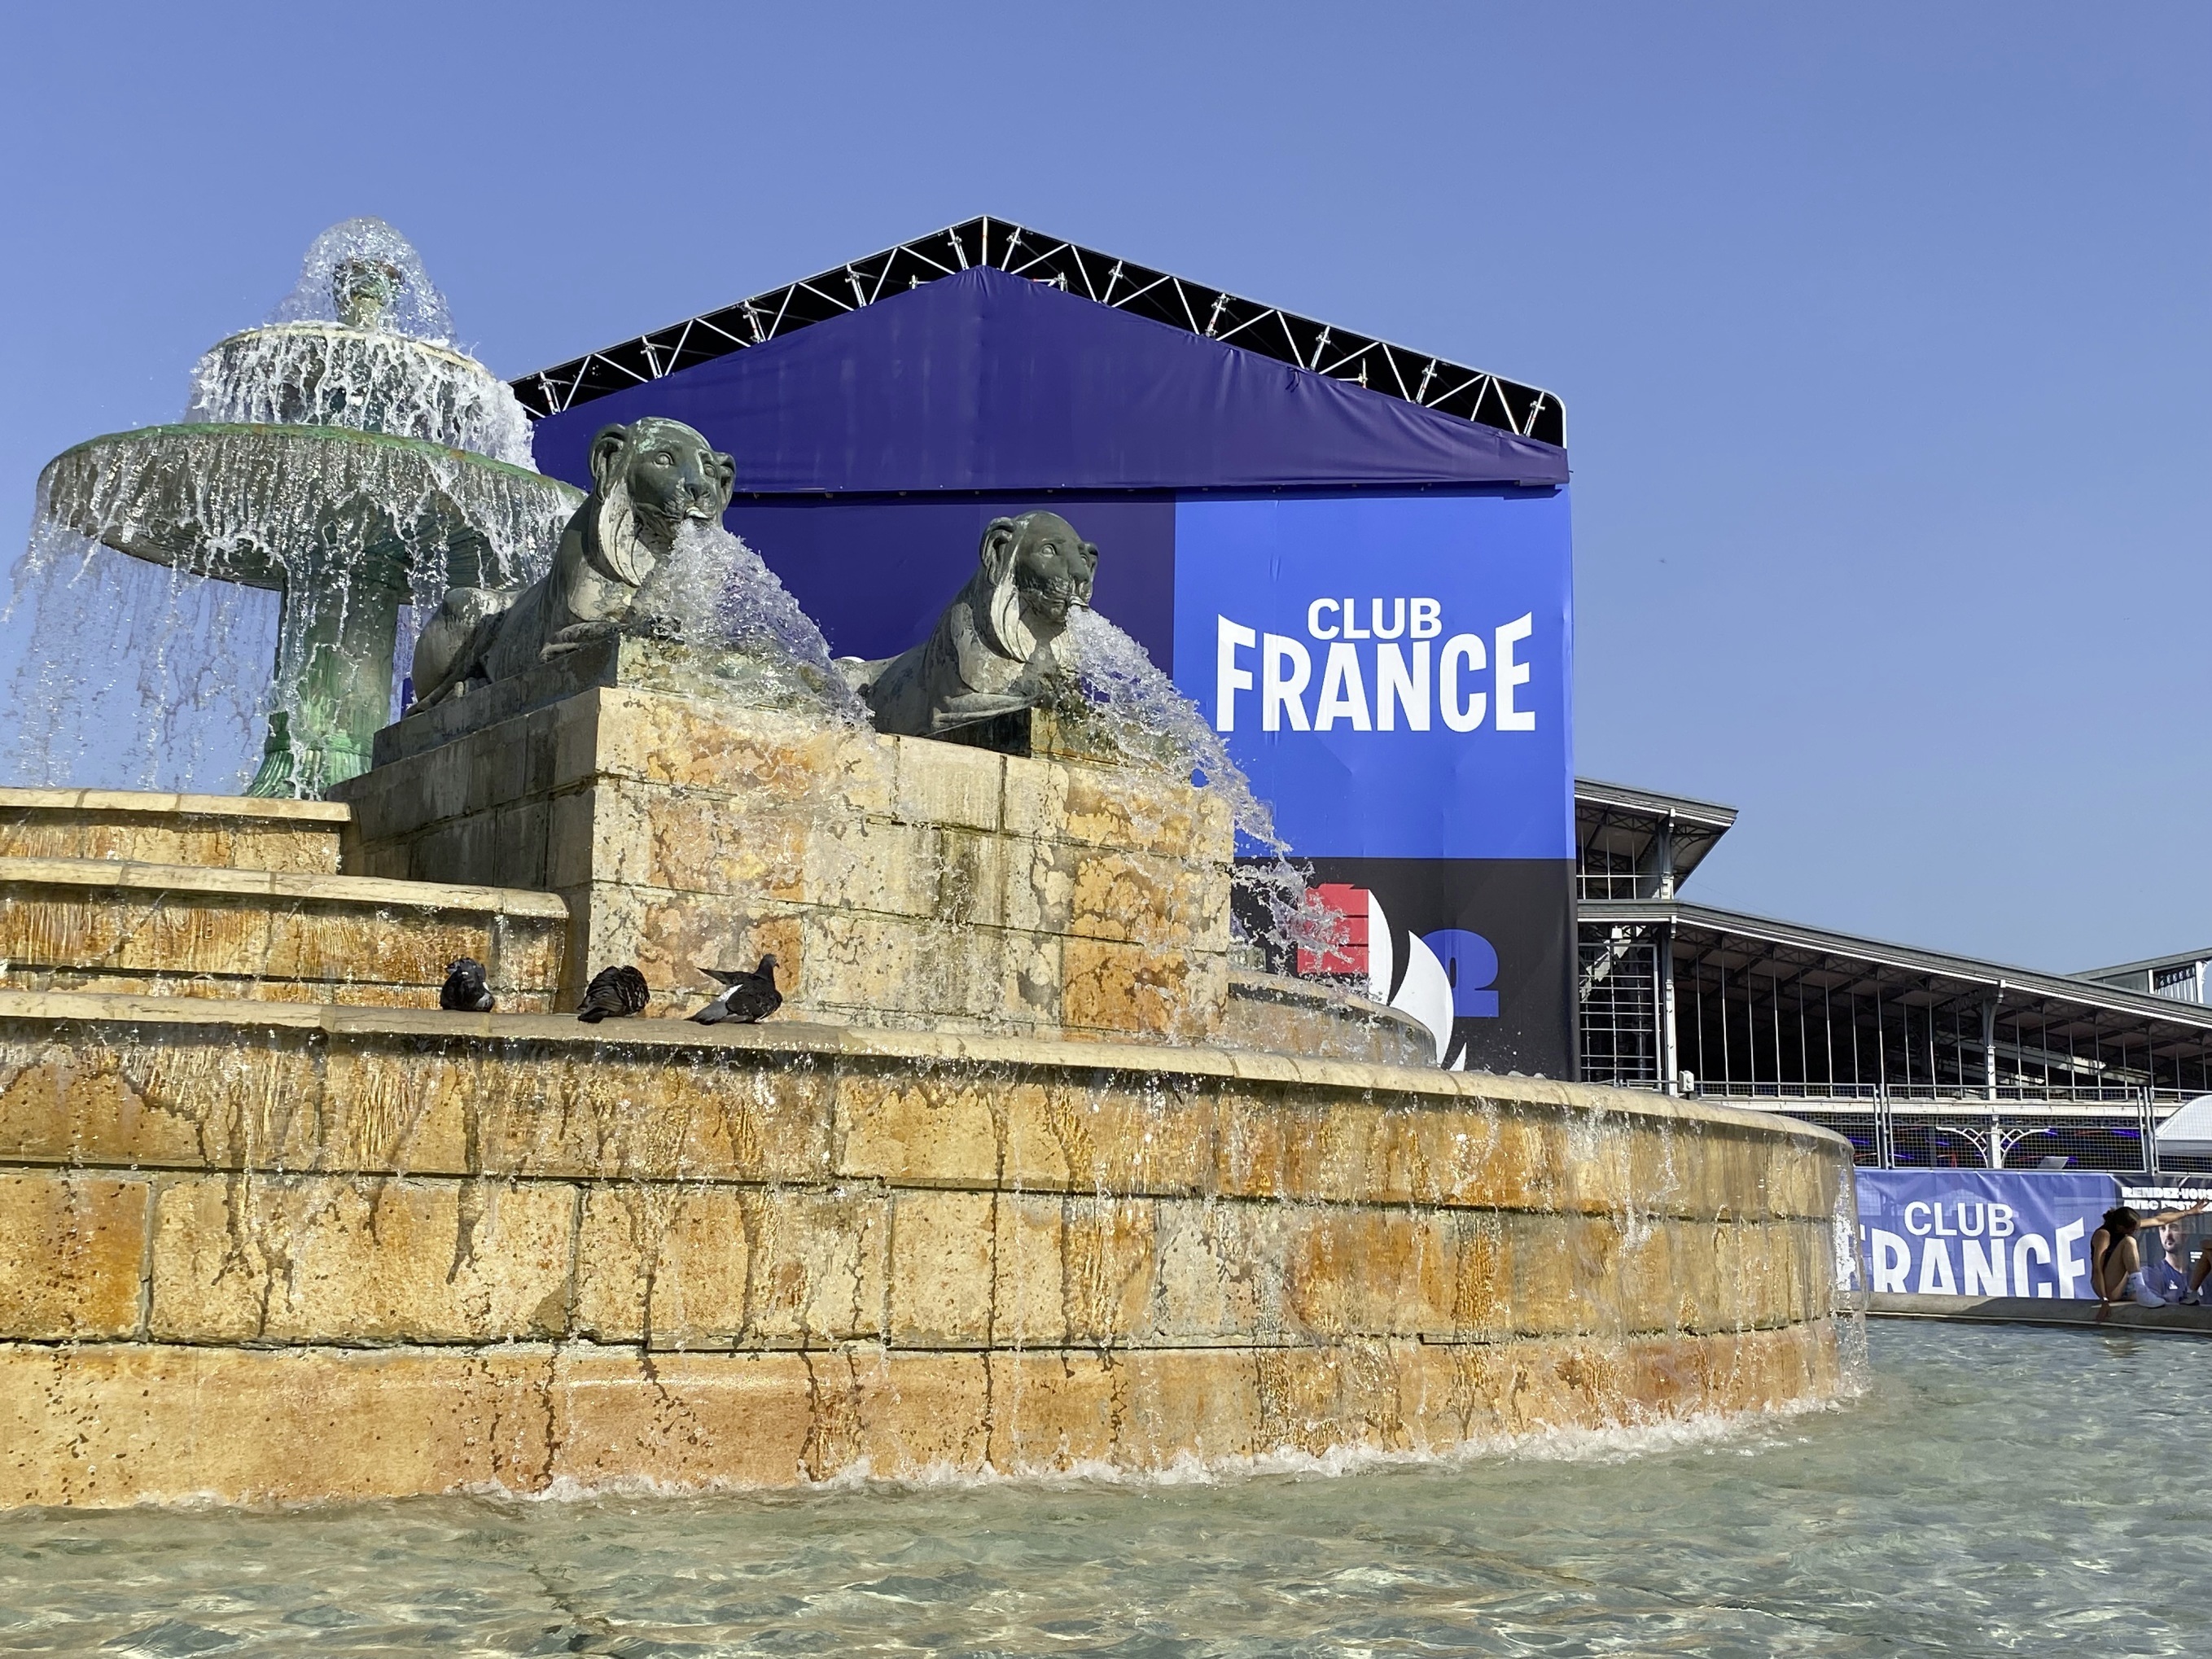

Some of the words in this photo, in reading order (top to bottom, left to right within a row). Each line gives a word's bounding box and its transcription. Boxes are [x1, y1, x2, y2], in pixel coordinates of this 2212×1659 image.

[1307, 598, 1443, 640] CLUB
[1216, 611, 1535, 733] FRANCE
[1904, 1201, 2014, 1237] CLUB
[2123, 1200, 2159, 1210] AVEC
